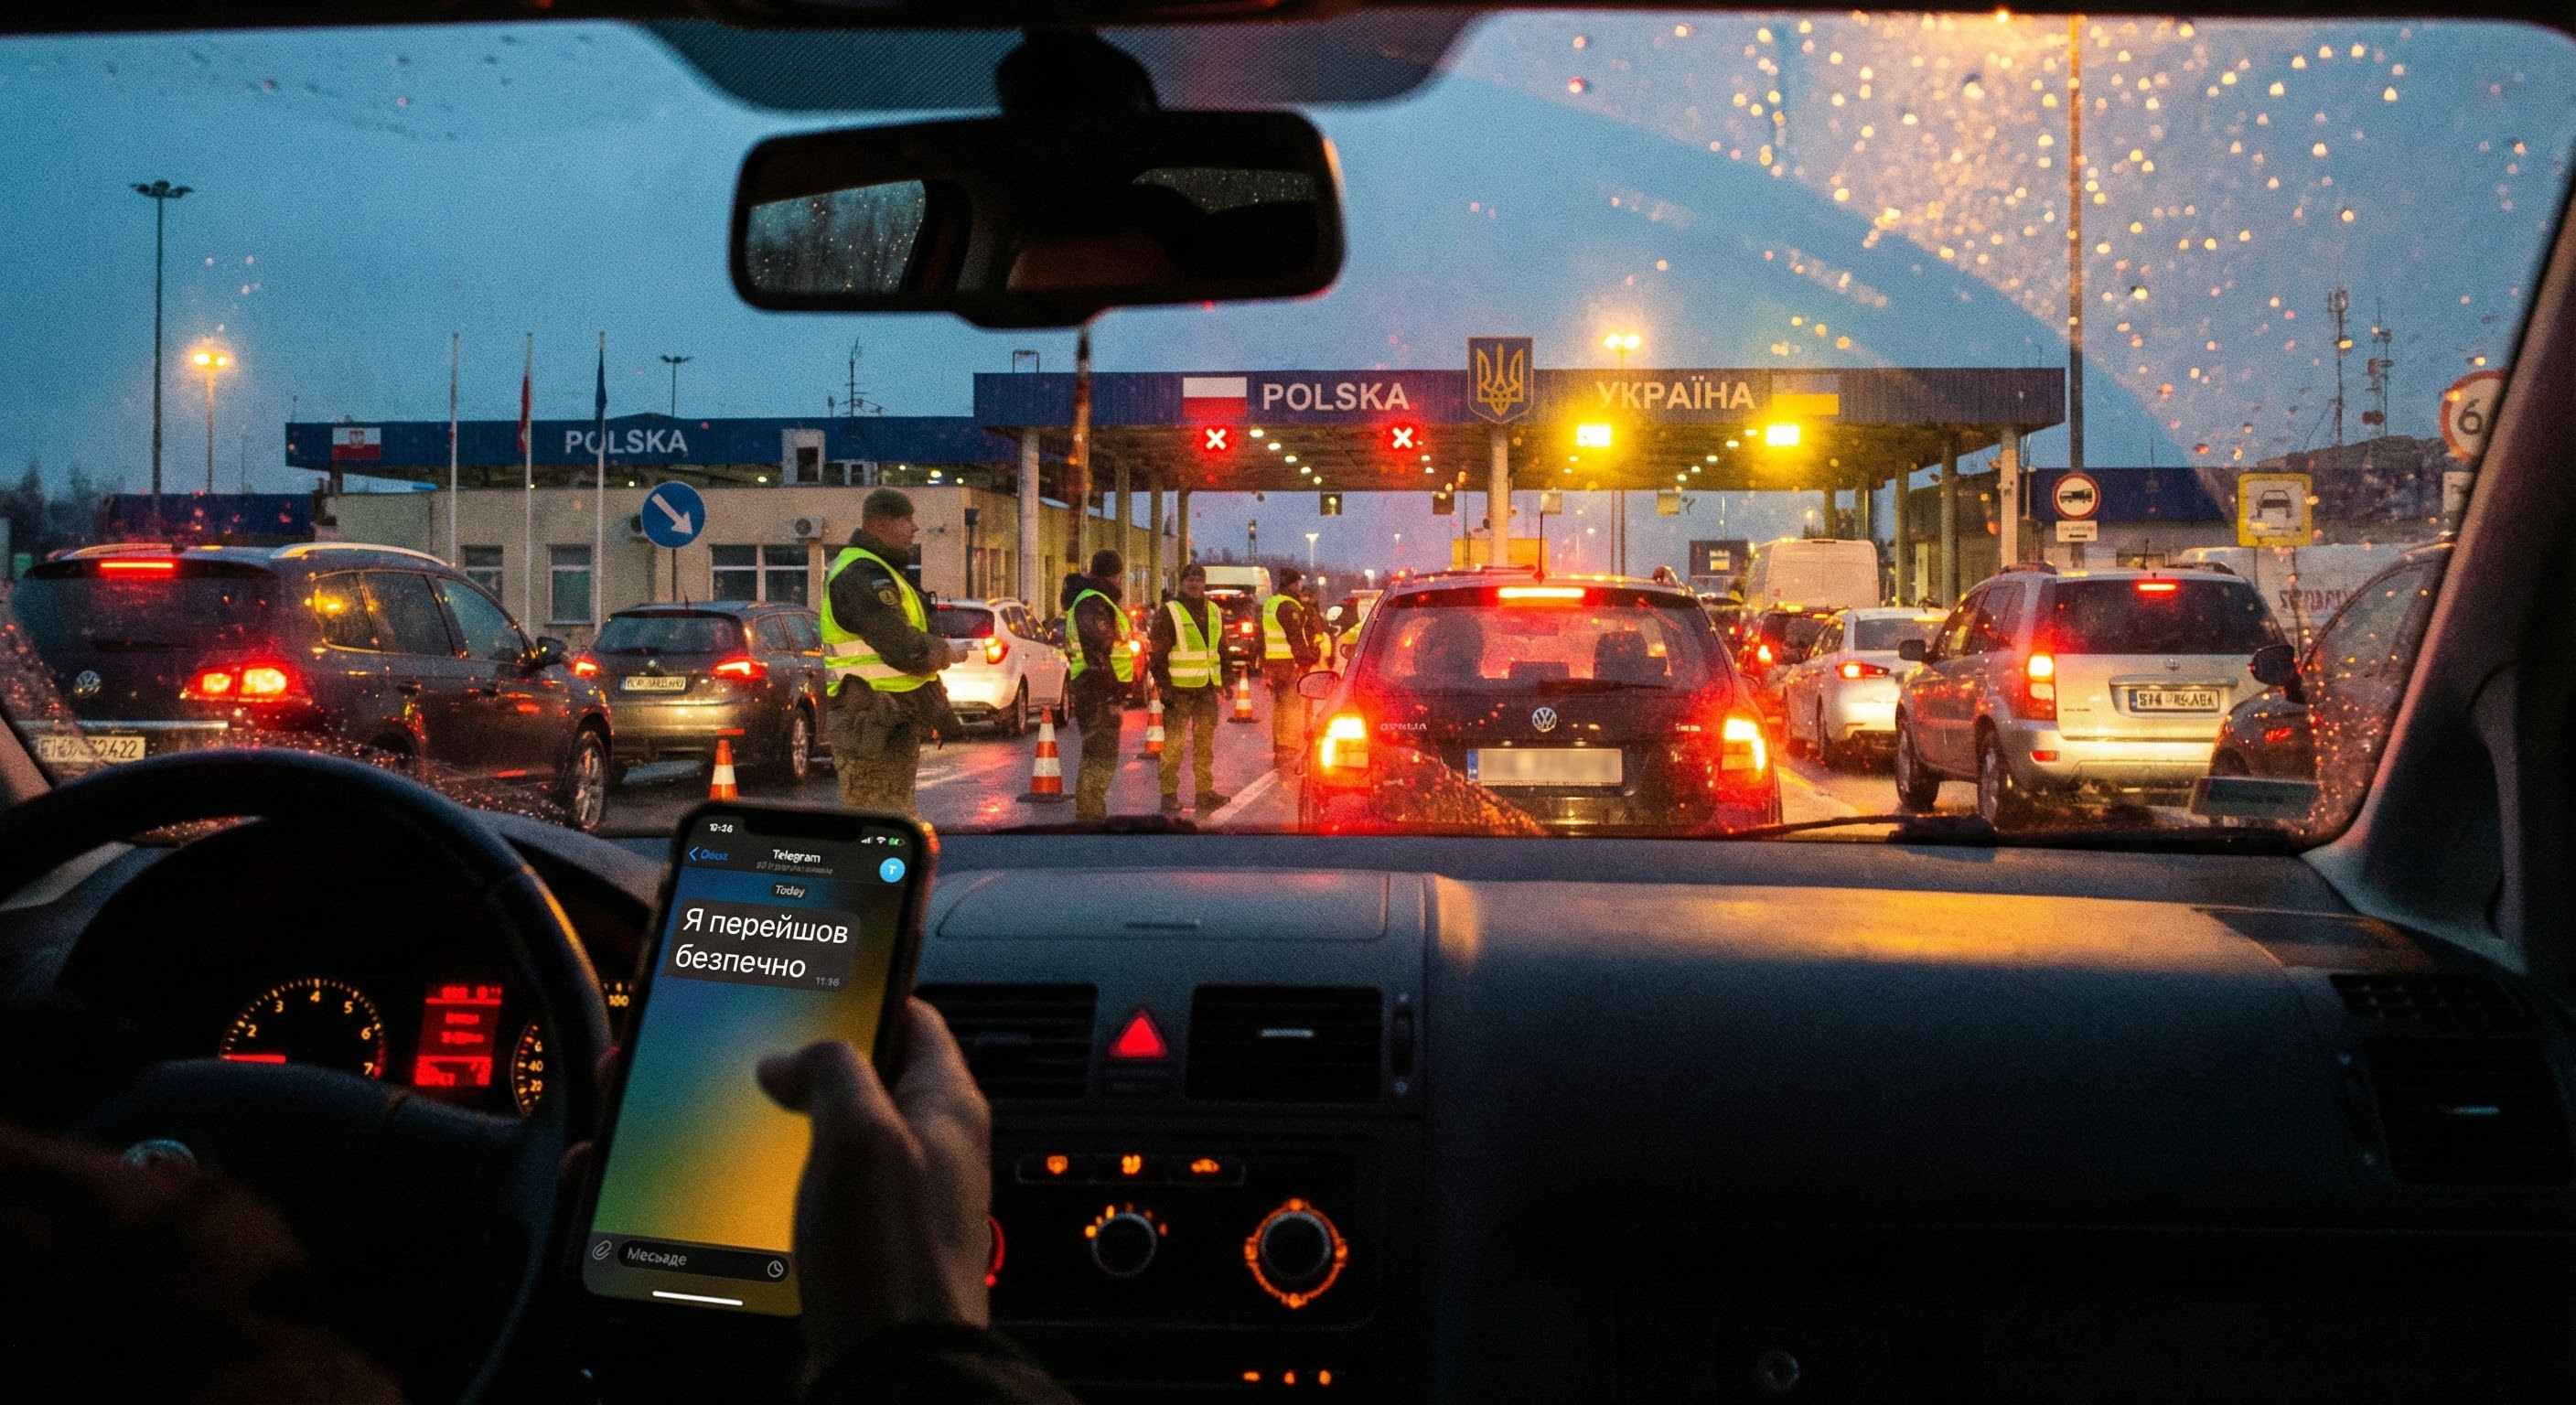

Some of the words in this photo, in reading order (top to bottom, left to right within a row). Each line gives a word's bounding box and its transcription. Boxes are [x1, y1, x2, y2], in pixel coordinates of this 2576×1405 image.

[1262, 382, 1411, 411] POLSKA
[1595, 375, 1755, 410] УКРАЇНА
[564, 429, 689, 456] POLSKA
[771, 849, 821, 864] Telegram
[775, 885, 806, 898] Today
[682, 907, 704, 932] Я
[709, 914, 848, 944] перейшов
[675, 943, 806, 978] безпечно
[309, 990, 321, 1003] 4
[274, 999, 284, 1013] 3
[343, 1000, 354, 1014] 5
[246, 1024, 258, 1038] 2
[360, 1026, 371, 1041] 6
[363, 1061, 374, 1076] 7
